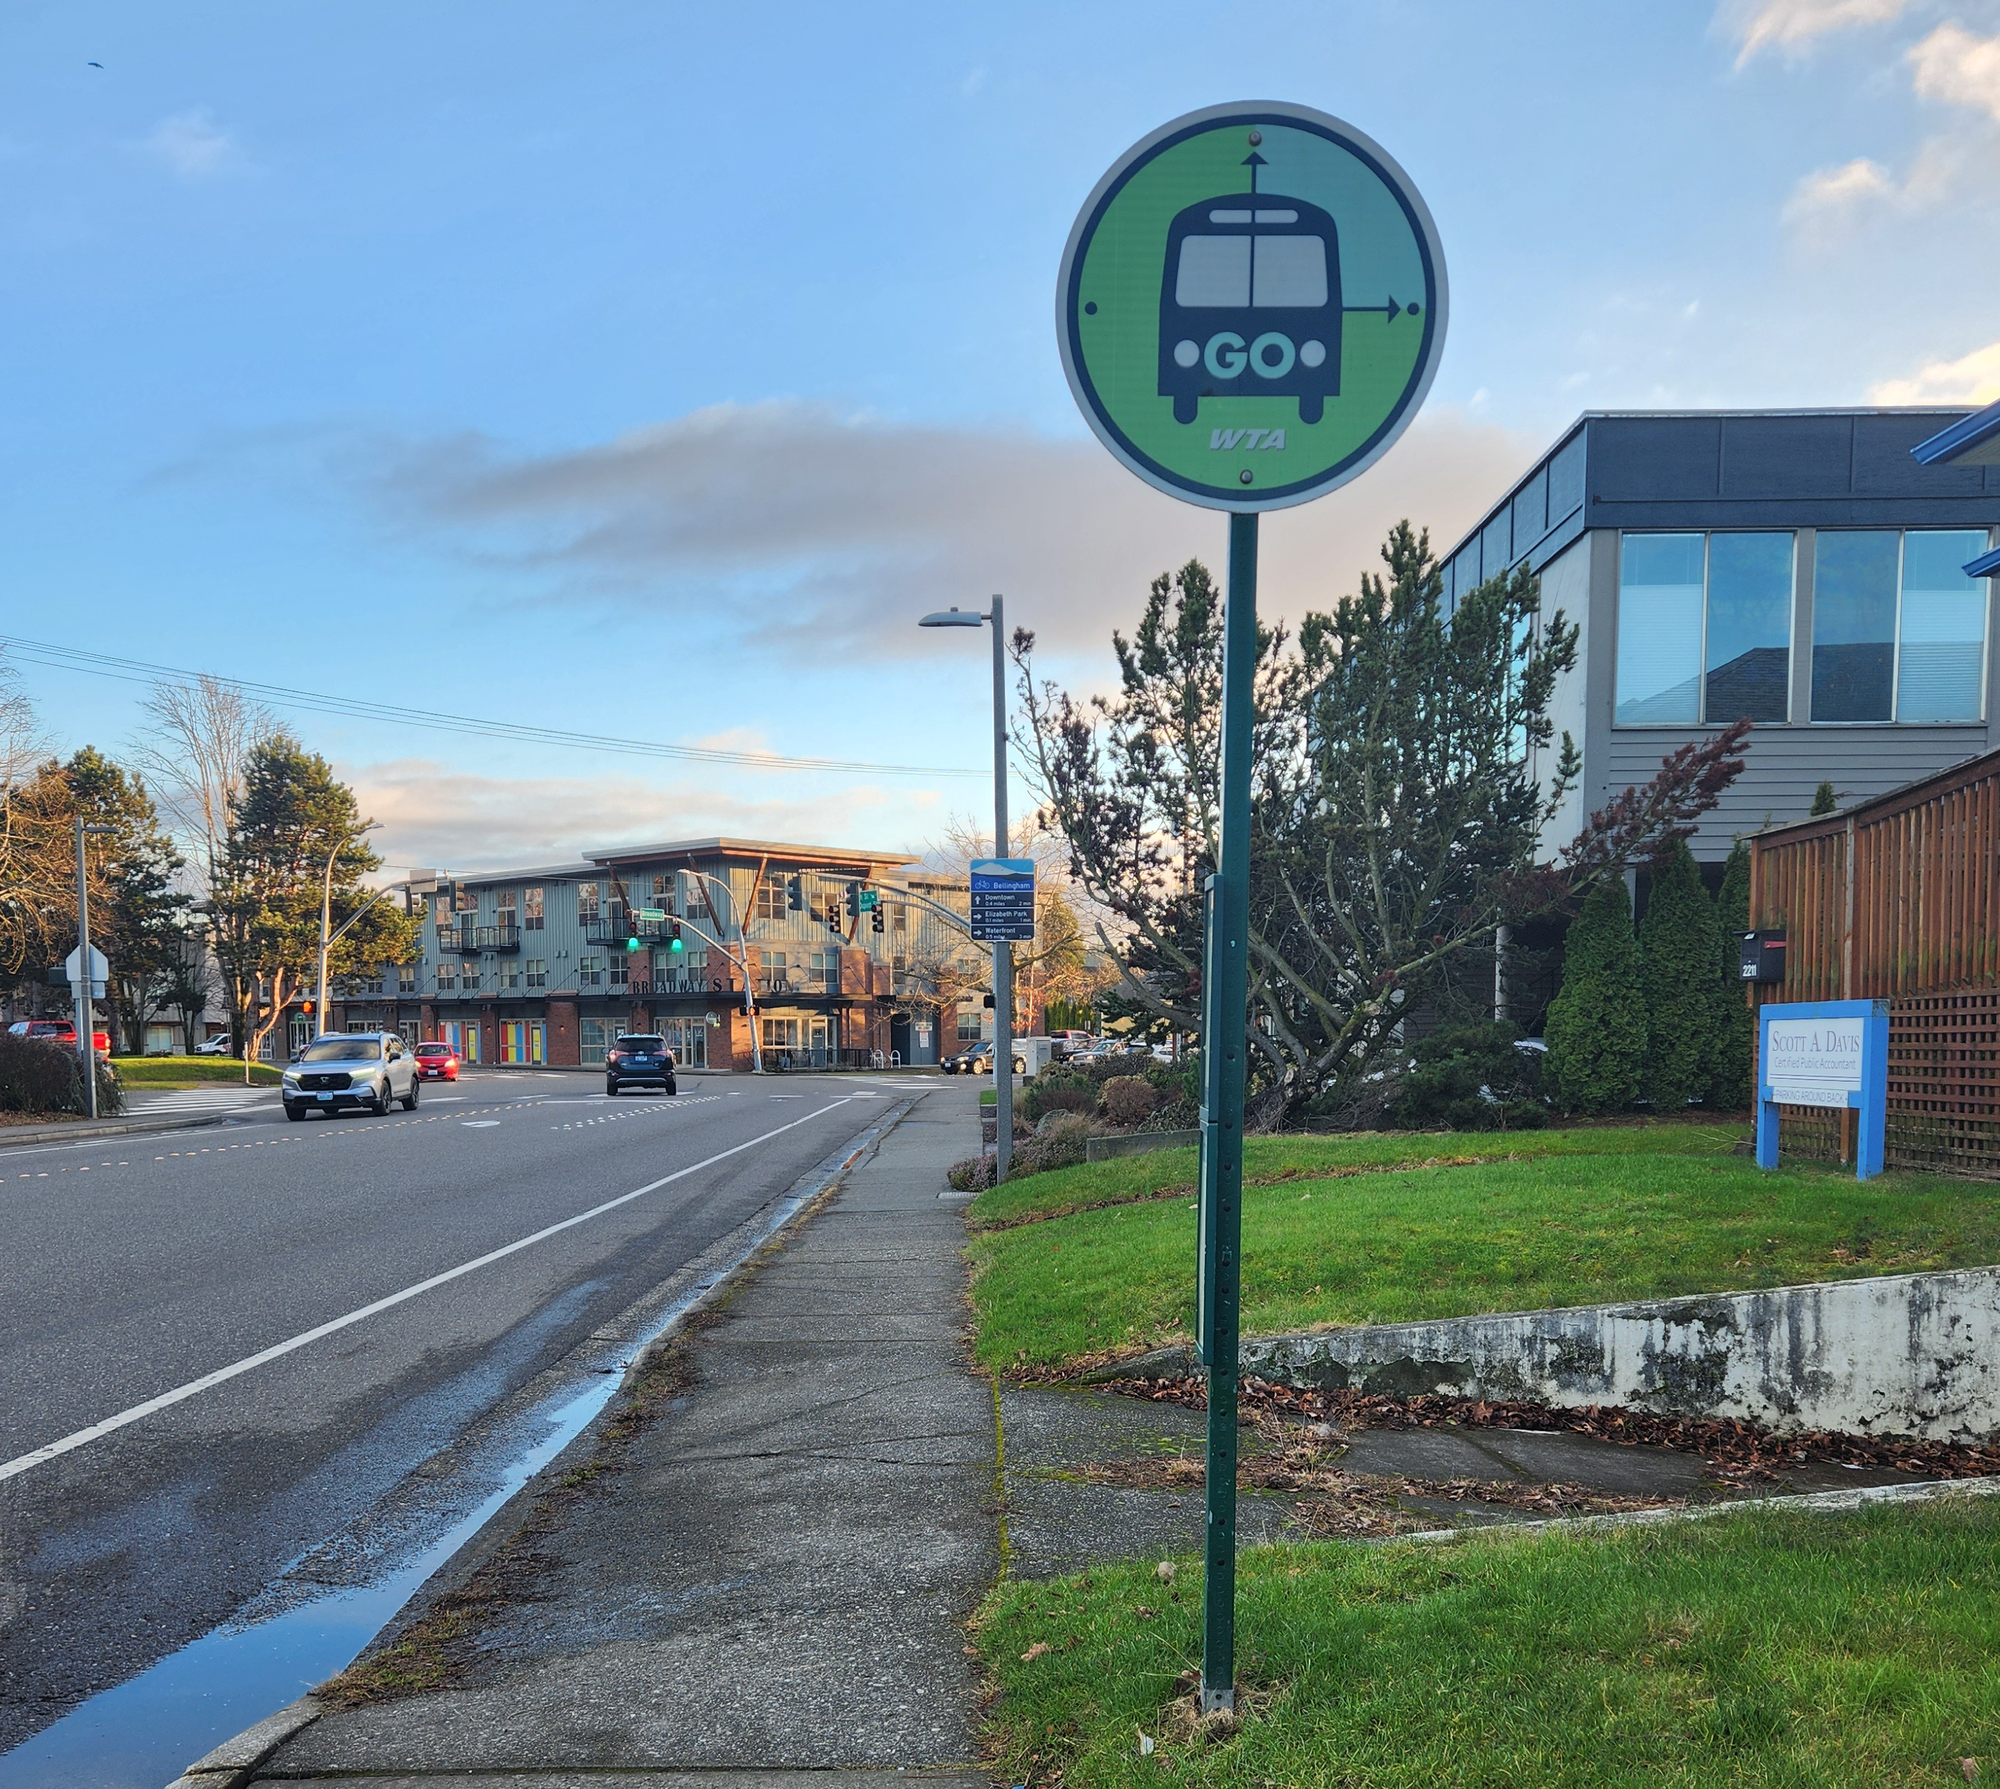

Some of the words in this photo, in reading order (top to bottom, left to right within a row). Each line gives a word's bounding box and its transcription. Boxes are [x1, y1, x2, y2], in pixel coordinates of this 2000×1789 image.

[1204, 331, 1296, 379] GO
[1210, 428, 1286, 451] WTA
[993, 882, 1031, 890] Bellingham
[1742, 964, 1757, 977] 2211
[632, 979, 705, 994] BROADWAY
[712, 977, 795, 994] STTION
[1772, 1030, 1808, 1052] SCOTT
[1826, 1030, 1860, 1053] DAVIS
[1774, 1056, 1800, 1069] Certified
[1800, 1057, 1820, 1069] Public
[1820, 1057, 1857, 1070] Accountant
[1801, 1091, 1827, 1103] AROUND
